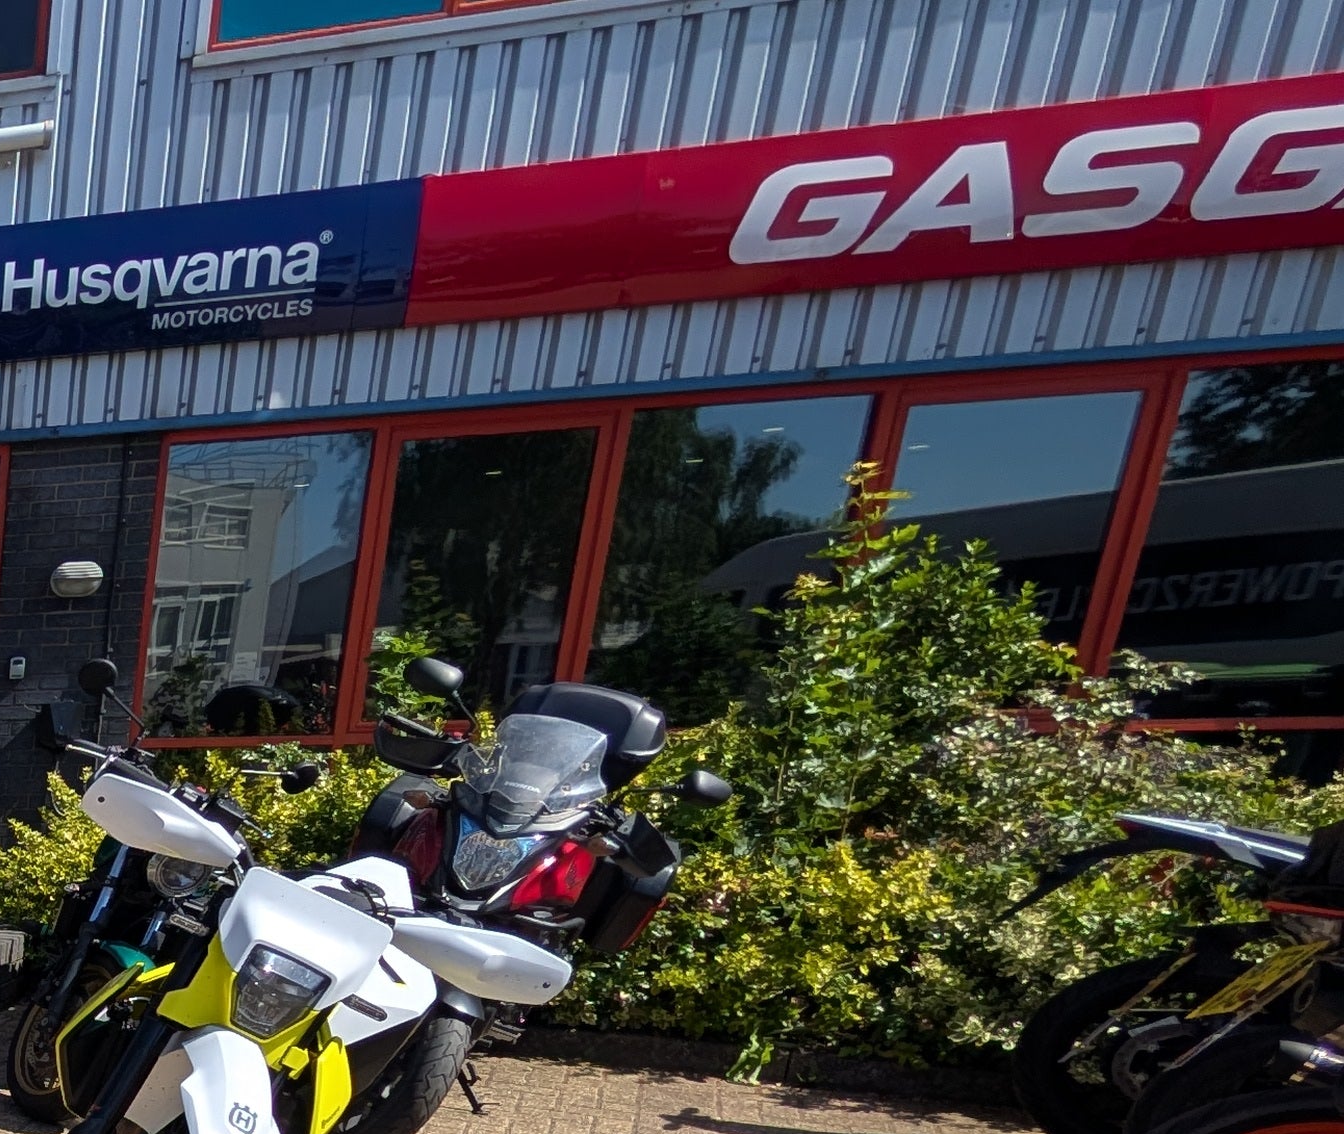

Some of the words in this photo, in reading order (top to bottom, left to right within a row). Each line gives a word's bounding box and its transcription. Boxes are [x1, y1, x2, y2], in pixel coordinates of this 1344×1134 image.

[728, 104, 1344, 265] GASG
[151, 299, 314, 331] MOTORCYCLES
[504, 780, 541, 794] HONDA
